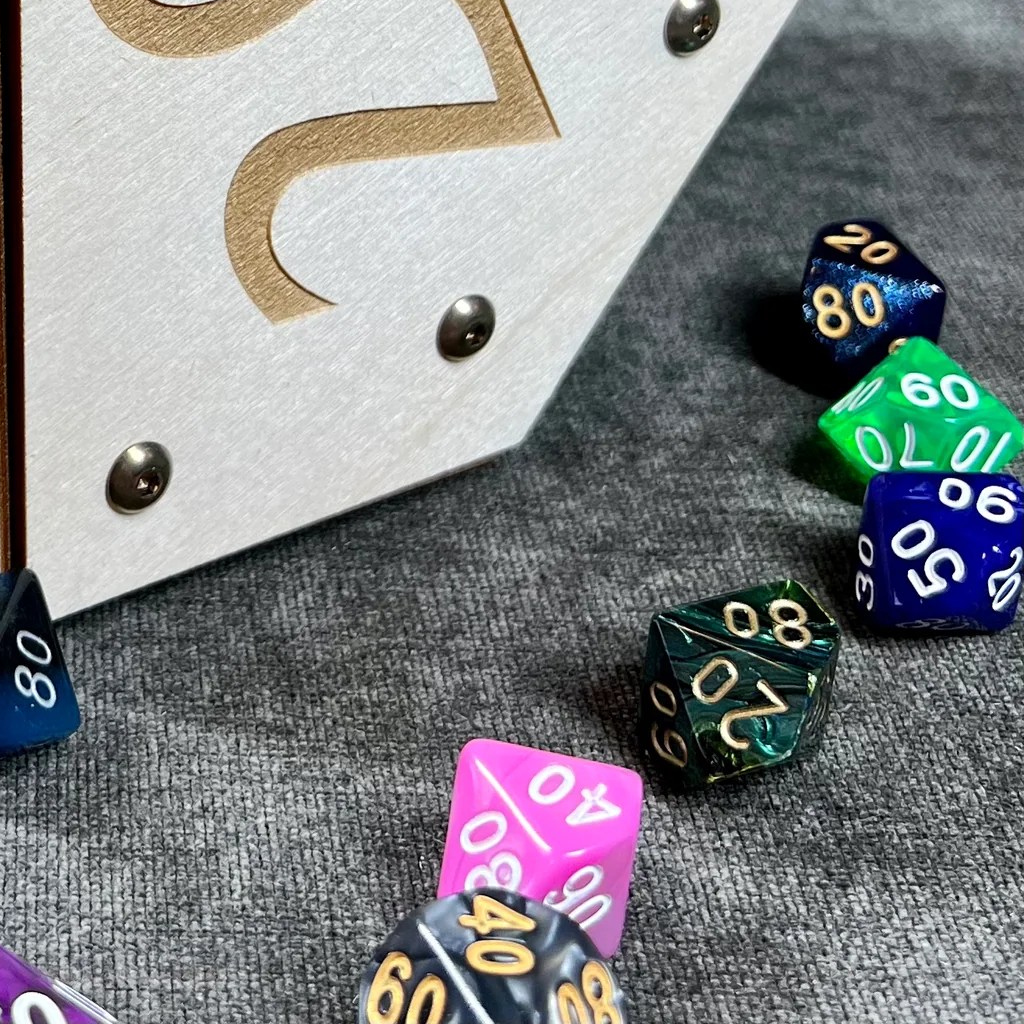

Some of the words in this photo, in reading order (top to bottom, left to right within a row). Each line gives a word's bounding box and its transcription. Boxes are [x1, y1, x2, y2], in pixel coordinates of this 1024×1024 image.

[823, 223, 900, 265] 20
[812, 282, 885, 340] 80
[900, 372, 979, 410] 60
[890, 519, 968, 598] 50
[722, 598, 813, 650] 80
[14, 629, 57, 709] 80
[691, 656, 789, 751] 20
[527, 764, 623, 826] 40
[458, 894, 537, 975] 40
